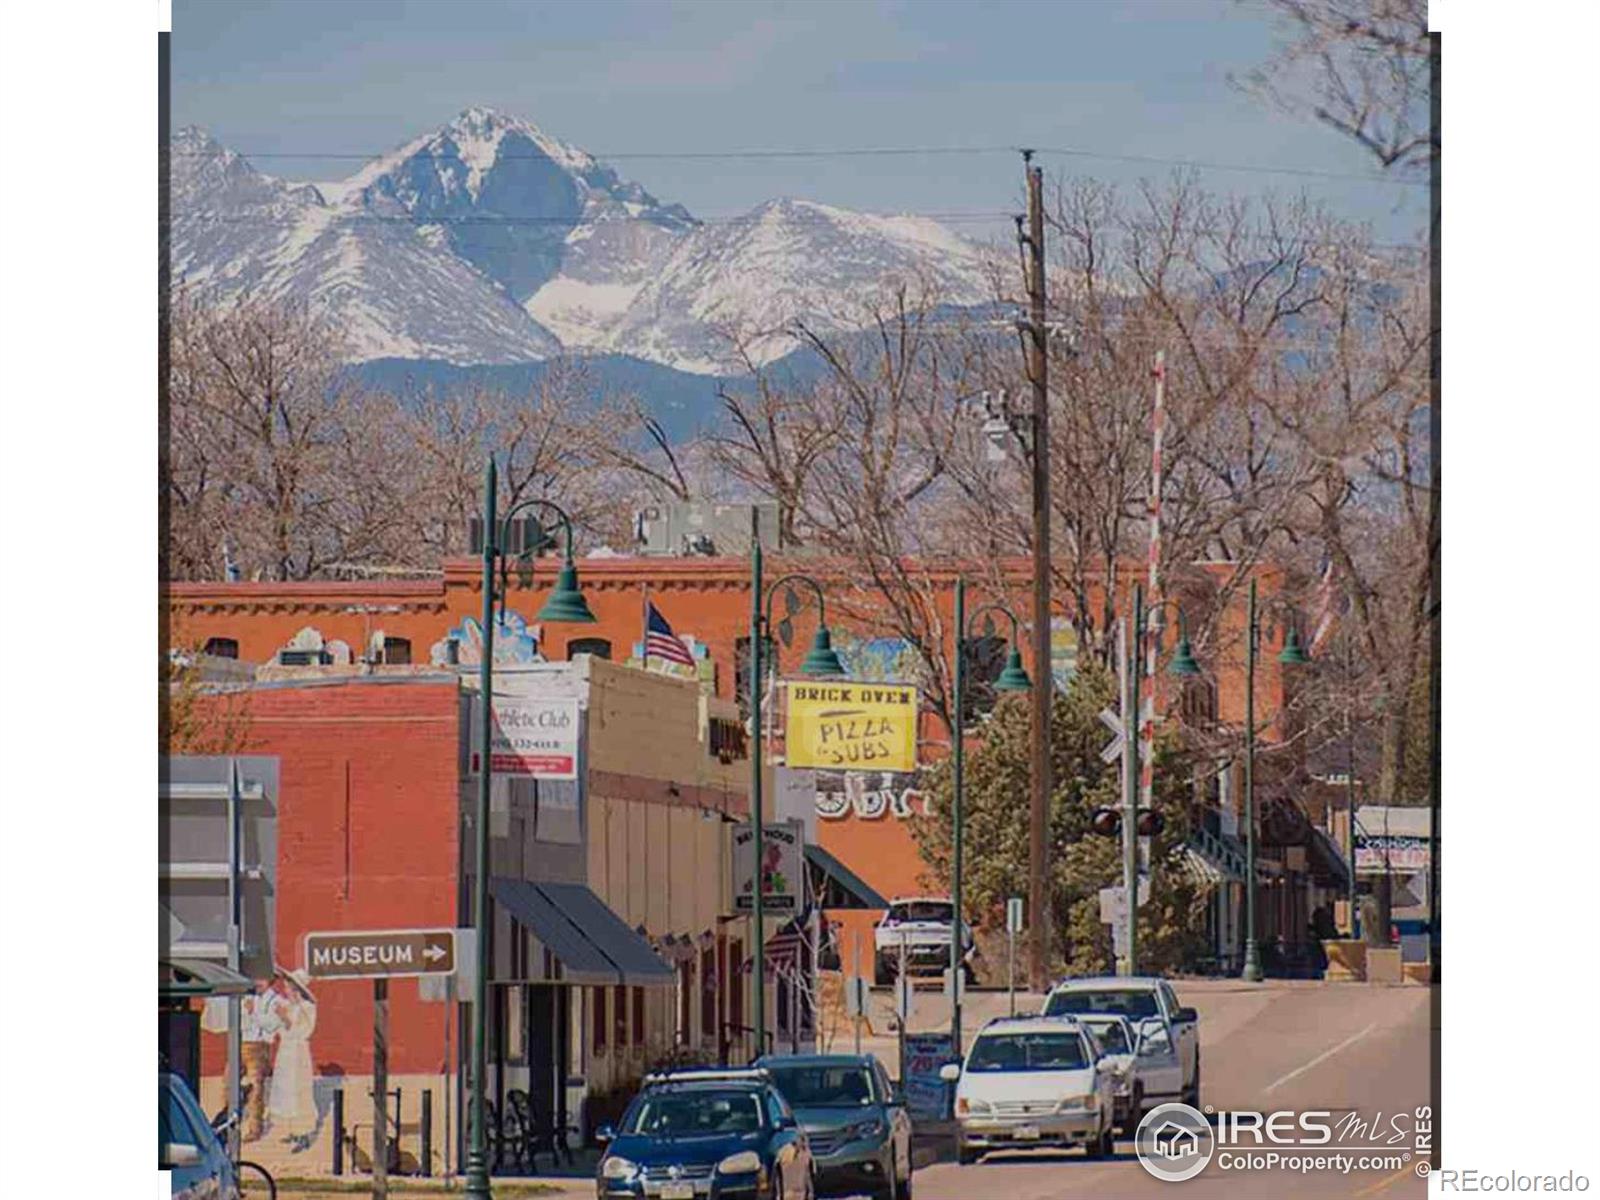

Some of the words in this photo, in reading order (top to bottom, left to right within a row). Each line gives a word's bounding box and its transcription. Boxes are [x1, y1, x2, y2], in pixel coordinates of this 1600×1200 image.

[795, 687, 853, 702] BRICK
[861, 690, 910, 704] OVEN
[494, 706, 537, 729] thletic
[539, 709, 571, 728] Club
[820, 717, 894, 743] PIZZA
[831, 739, 890, 764] SUBS
[313, 944, 413, 966] MUSEUM
